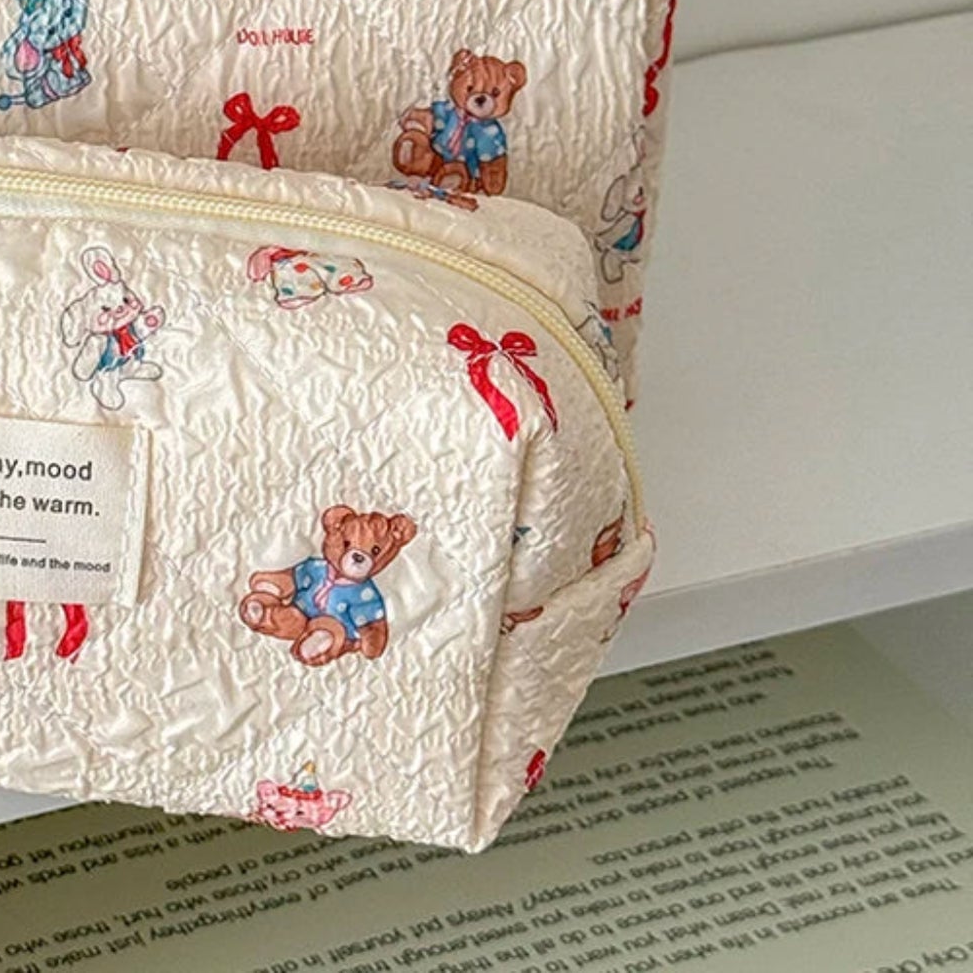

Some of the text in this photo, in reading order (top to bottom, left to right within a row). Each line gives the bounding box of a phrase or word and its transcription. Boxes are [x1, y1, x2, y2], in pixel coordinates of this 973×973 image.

[32, 499, 101, 517] warm.
[21, 557, 46, 569] and
[49, 558, 71, 570] the
[73, 561, 112, 574] mood
[795, 756, 834, 771] The
[625, 789, 689, 815] people
[692, 785, 713, 801] of
[891, 791, 928, 809] you
[780, 798, 832, 817] hurts
[746, 810, 781, 825] the
[182, 826, 226, 844] with
[697, 819, 745, 839] other
[867, 819, 905, 838] you
[927, 826, 965, 844] you
[121, 842, 164, 859] kiss
[165, 837, 179, 848] a
[708, 838, 761, 857] hope
[820, 832, 870, 850] have
[881, 838, 931, 857] have
[27, 848, 56, 863] let
[80, 852, 118, 872] and
[304, 855, 347, 875] who
[378, 857, 413, 873] the
[683, 850, 709, 865] to
[748, 844, 819, 870] enough
[840, 850, 881, 869] only
[26, 863, 76, 884] ends
[236, 859, 258, 875] of
[628, 858, 682, 879] make
[800, 862, 838, 879] one
[904, 857, 948, 874] hug
[165, 863, 232, 891] people
[332, 867, 378, 891] best
[589, 869, 627, 889] you
[651, 863, 751, 895] happiness
[767, 873, 802, 888] life
[856, 867, 908, 887] them
[306, 883, 328, 900] of
[520, 882, 591, 911] happy?
[626, 889, 652, 902] to
[726, 881, 765, 901] and
[827, 881, 857, 896] for
[900, 878, 960, 899] There
[164, 895, 208, 913] who
[570, 896, 625, 918] make
[687, 892, 725, 909] one
[866, 892, 900, 908] are
[445, 902, 514, 927] Always
[530, 908, 569, 928] you
[614, 903, 686, 929] chance
[712, 901, 781, 927] Dream
[775, 902, 865, 933] moments
[51, 920, 111, 943] those
[408, 916, 444, 938] put
[558, 929, 586, 944] do
[589, 923, 614, 936] to
[661, 920, 712, 942] what
[753, 927, 777, 940] in
[4, 937, 48, 956] who
[106, 930, 146, 954] just
[327, 928, 407, 963] yourself
[530, 937, 556, 955] all
[621, 931, 661, 951] you
[719, 933, 756, 949] life
[44, 945, 101, 968] make
[301, 954, 325, 967] in
[493, 946, 530, 962] the
[570, 945, 622, 968] want
[623, 954, 662, 971] you
[663, 943, 718, 964] when
[544, 959, 569, 971] to
